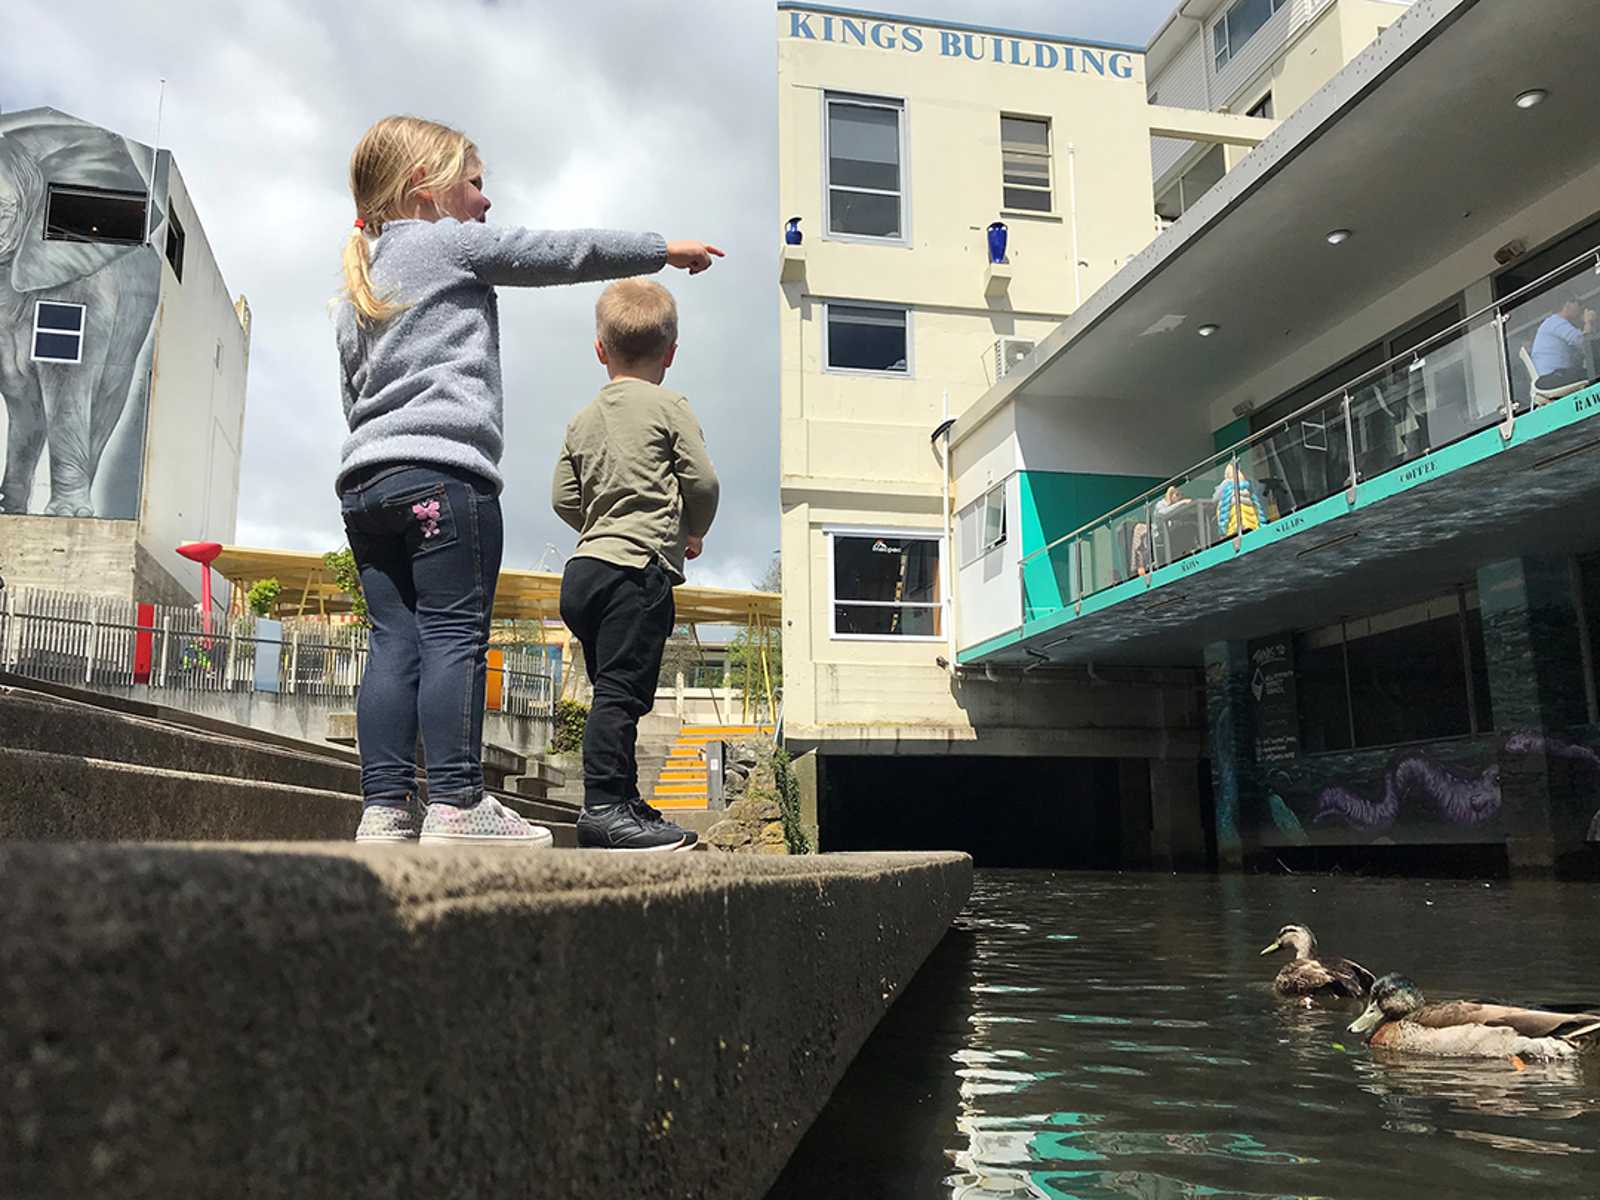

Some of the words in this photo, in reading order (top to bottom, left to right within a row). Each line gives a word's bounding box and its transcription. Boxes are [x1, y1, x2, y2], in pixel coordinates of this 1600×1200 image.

[789, 11, 923, 52] KINGS
[938, 31, 1134, 79] BUILDING
[1399, 460, 1438, 483] COFFEE
